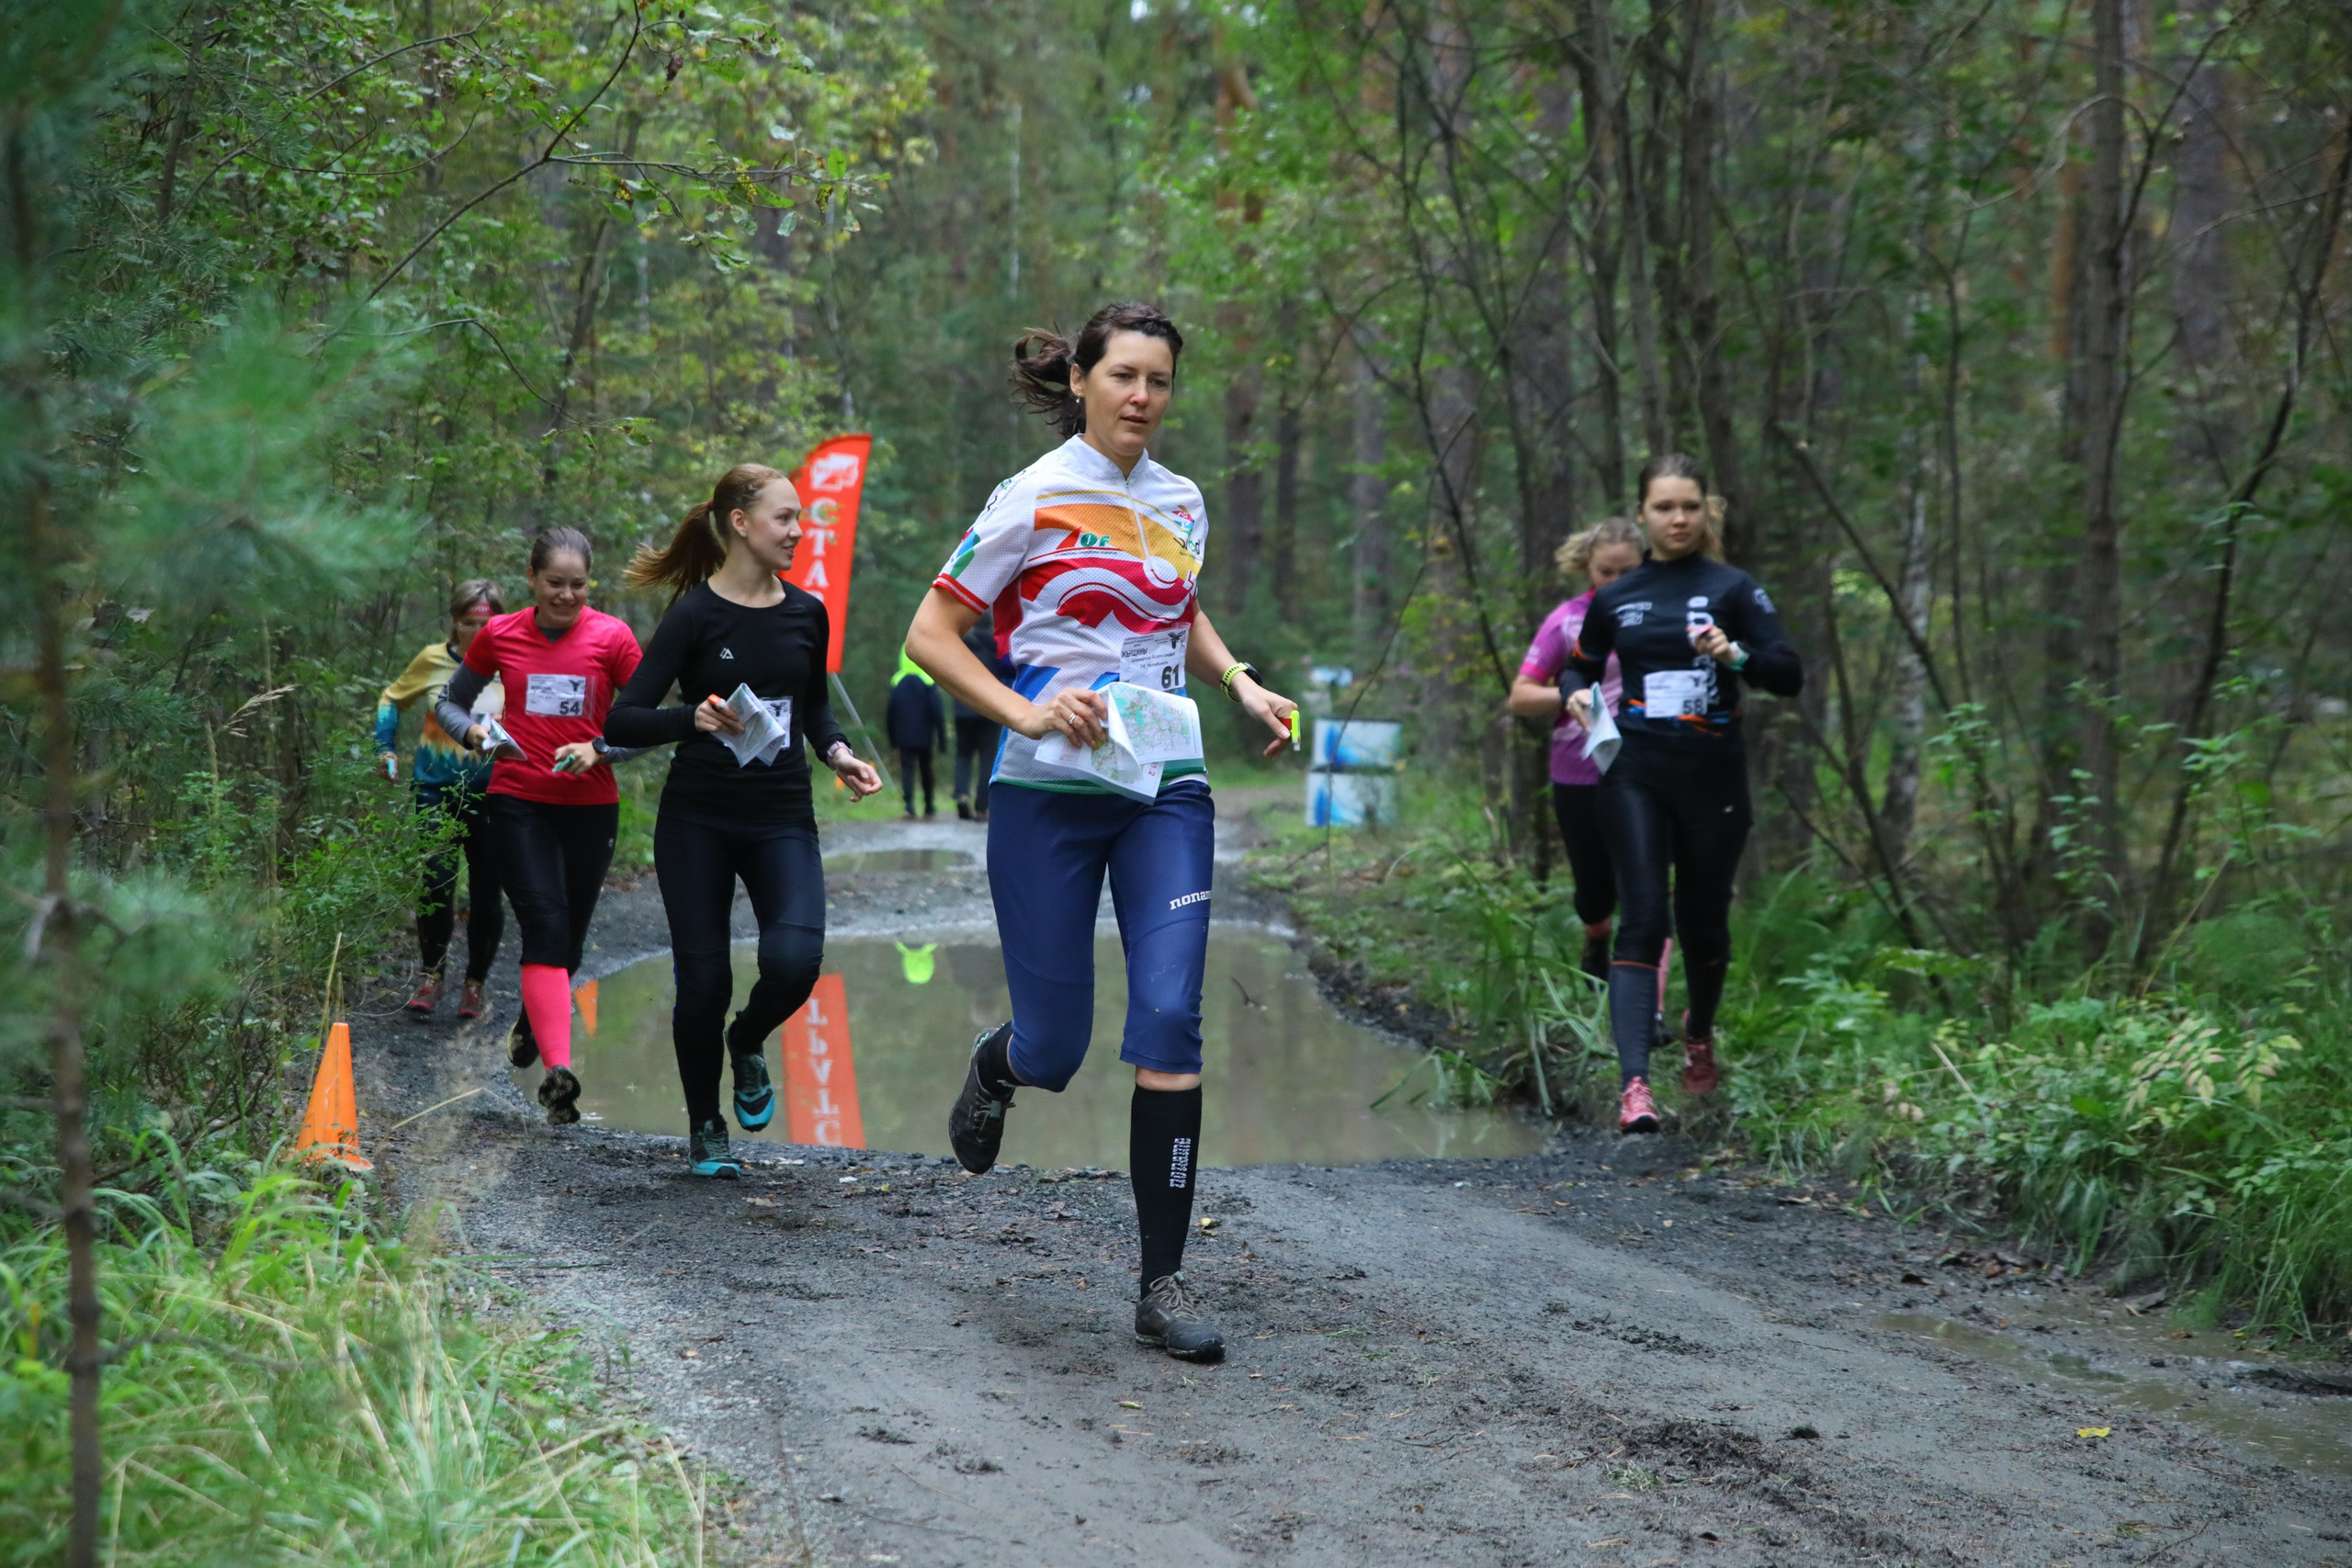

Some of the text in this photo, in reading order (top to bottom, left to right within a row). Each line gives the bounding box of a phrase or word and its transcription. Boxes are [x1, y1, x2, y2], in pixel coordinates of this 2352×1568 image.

[1161, 663, 1180, 689] 61
[559, 701, 581, 716] 54
[1683, 698, 1703, 716] 58
[1170, 1138, 1192, 1189] noname
